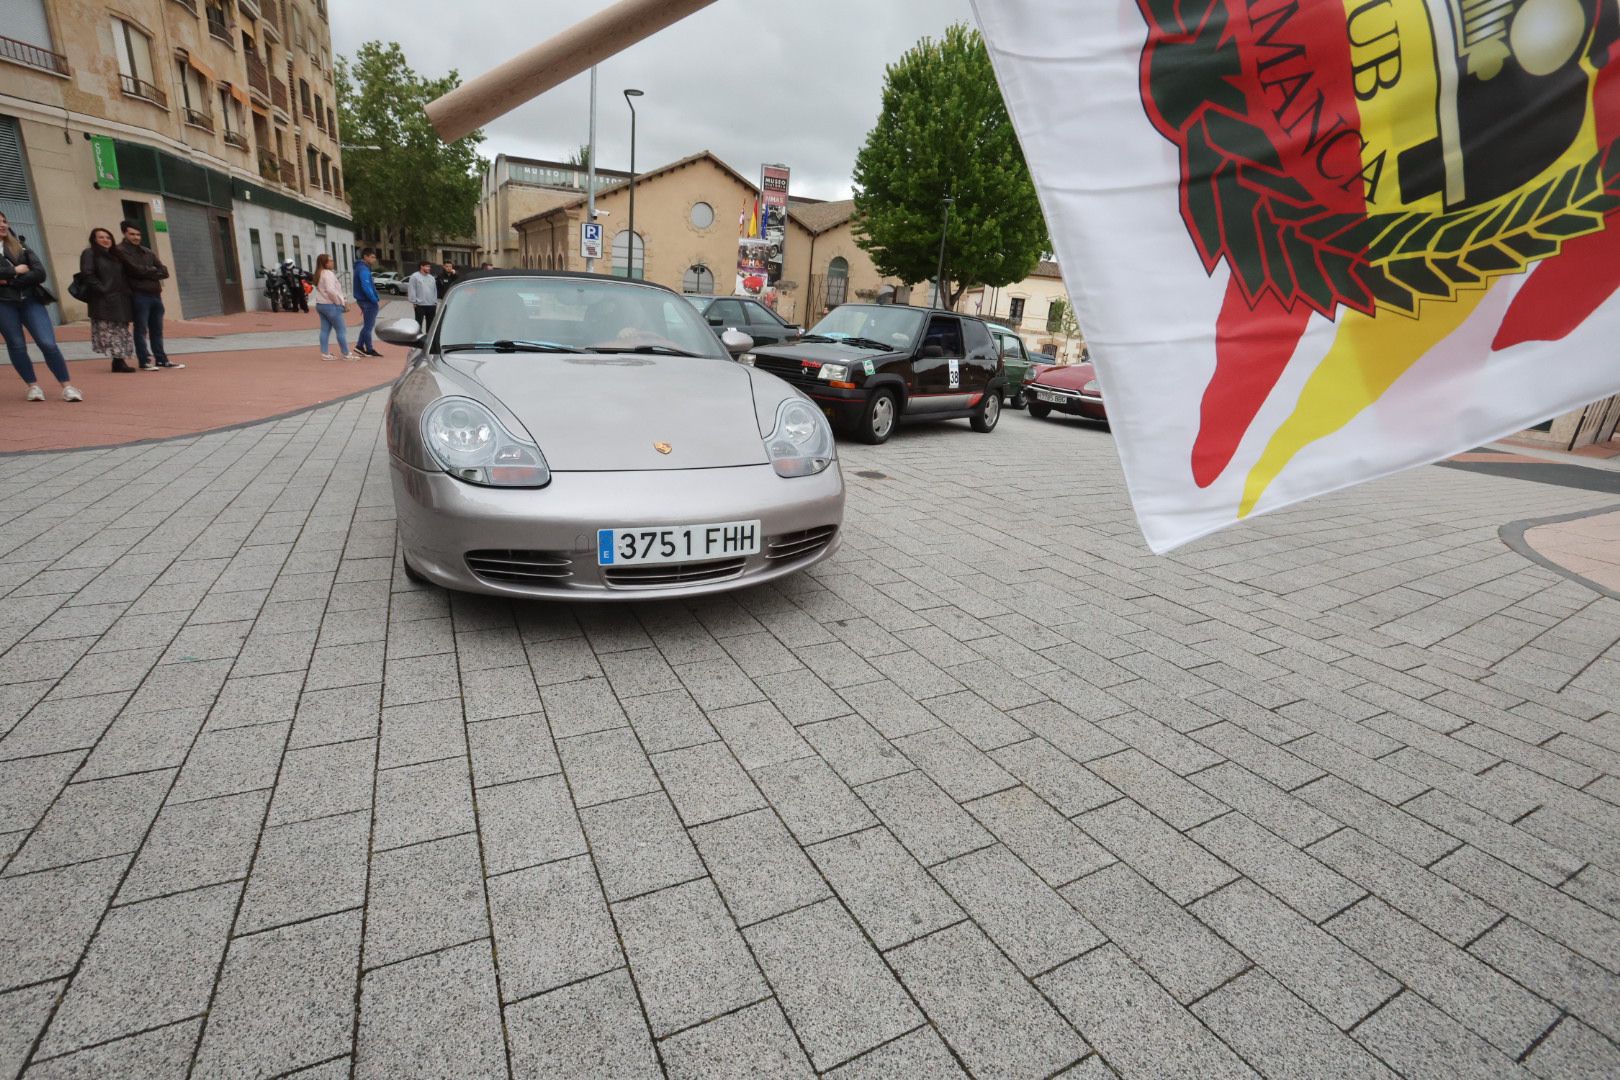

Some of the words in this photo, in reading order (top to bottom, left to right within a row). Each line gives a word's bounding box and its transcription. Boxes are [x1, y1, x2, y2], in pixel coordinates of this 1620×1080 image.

[1246, 0, 1387, 205] MANCA
[524, 167, 559, 177] MUSEO
[765, 177, 786, 186] MUSEO
[950, 371, 959, 384] 38
[620, 530, 692, 560] 3751
[705, 524, 755, 554] FHH
[603, 551, 609, 559] E
